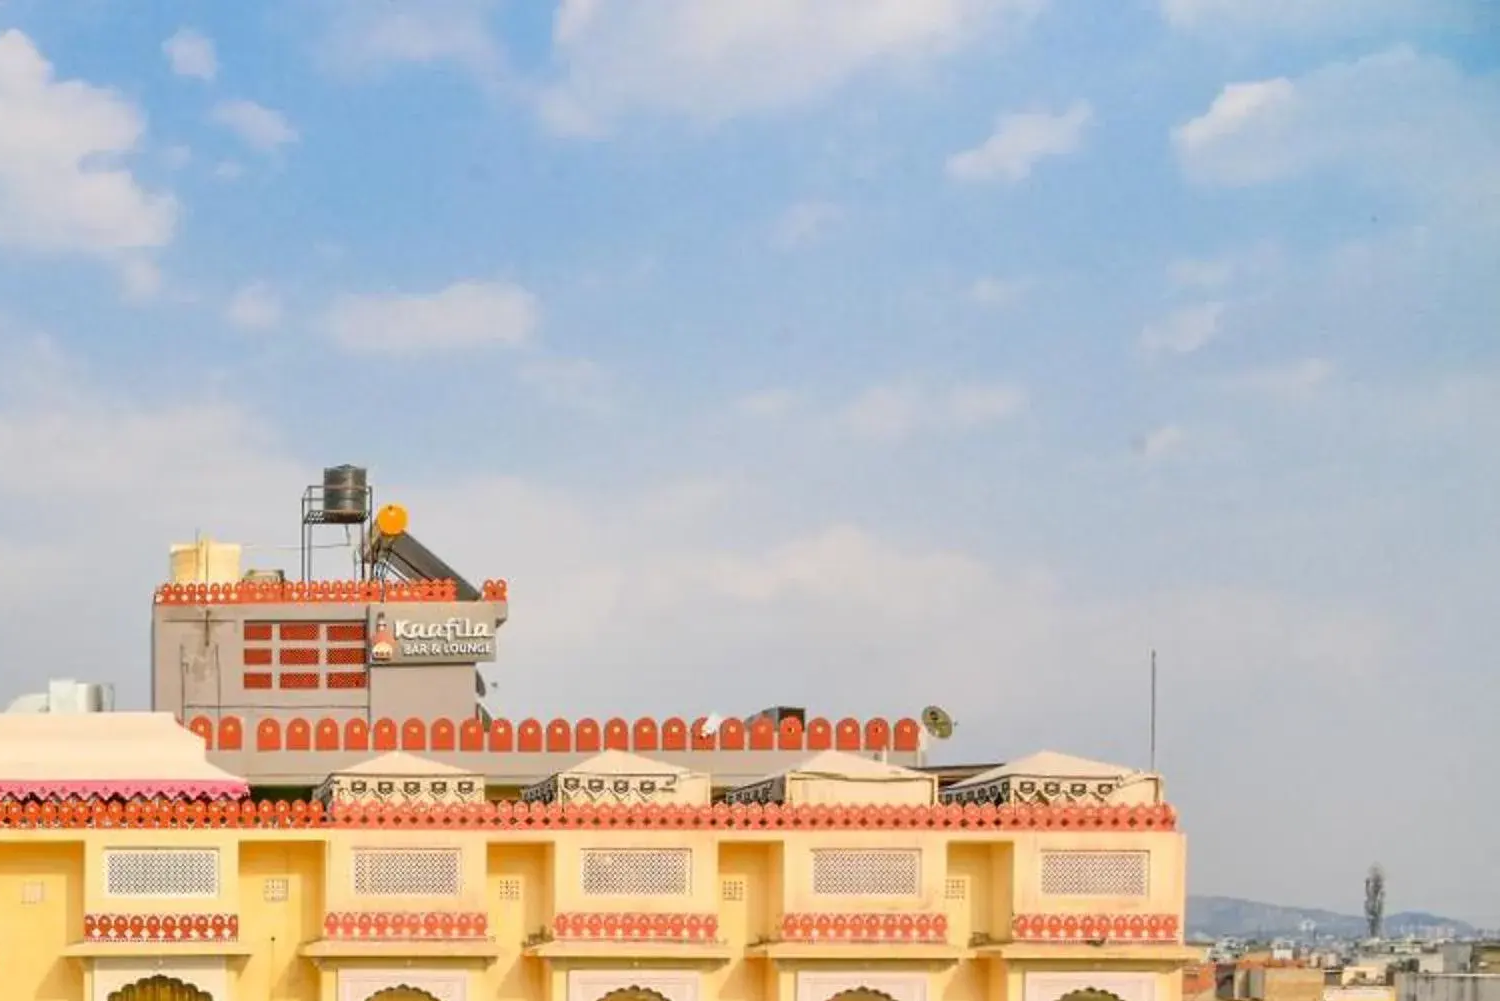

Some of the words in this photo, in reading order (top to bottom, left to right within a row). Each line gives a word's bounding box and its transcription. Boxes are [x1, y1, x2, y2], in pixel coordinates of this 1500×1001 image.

[394, 617, 495, 640] Kaafila
[403, 642, 428, 656] BAR
[431, 642, 442, 656] &
[445, 642, 491, 656] LOUNGE
